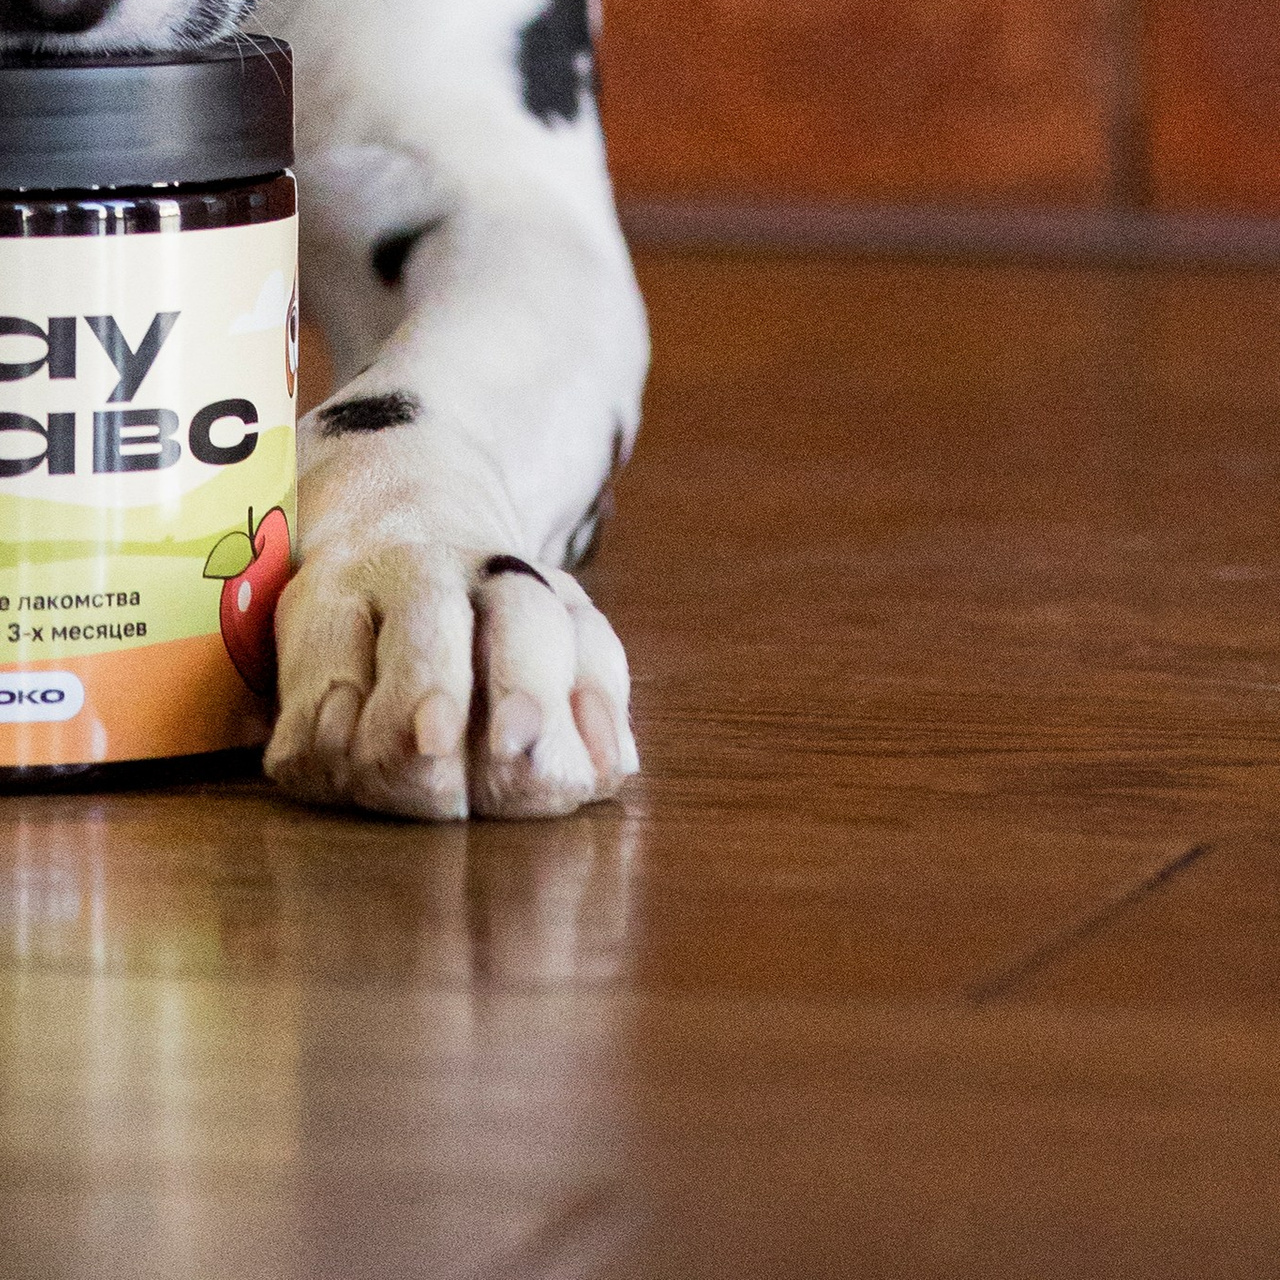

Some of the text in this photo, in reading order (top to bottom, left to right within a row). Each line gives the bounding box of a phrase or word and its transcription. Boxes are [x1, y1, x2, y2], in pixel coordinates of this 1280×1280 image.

[17, 592, 141, 611] лакомства
[7, 623, 44, 642] 3-х
[51, 621, 147, 641] месяцев
